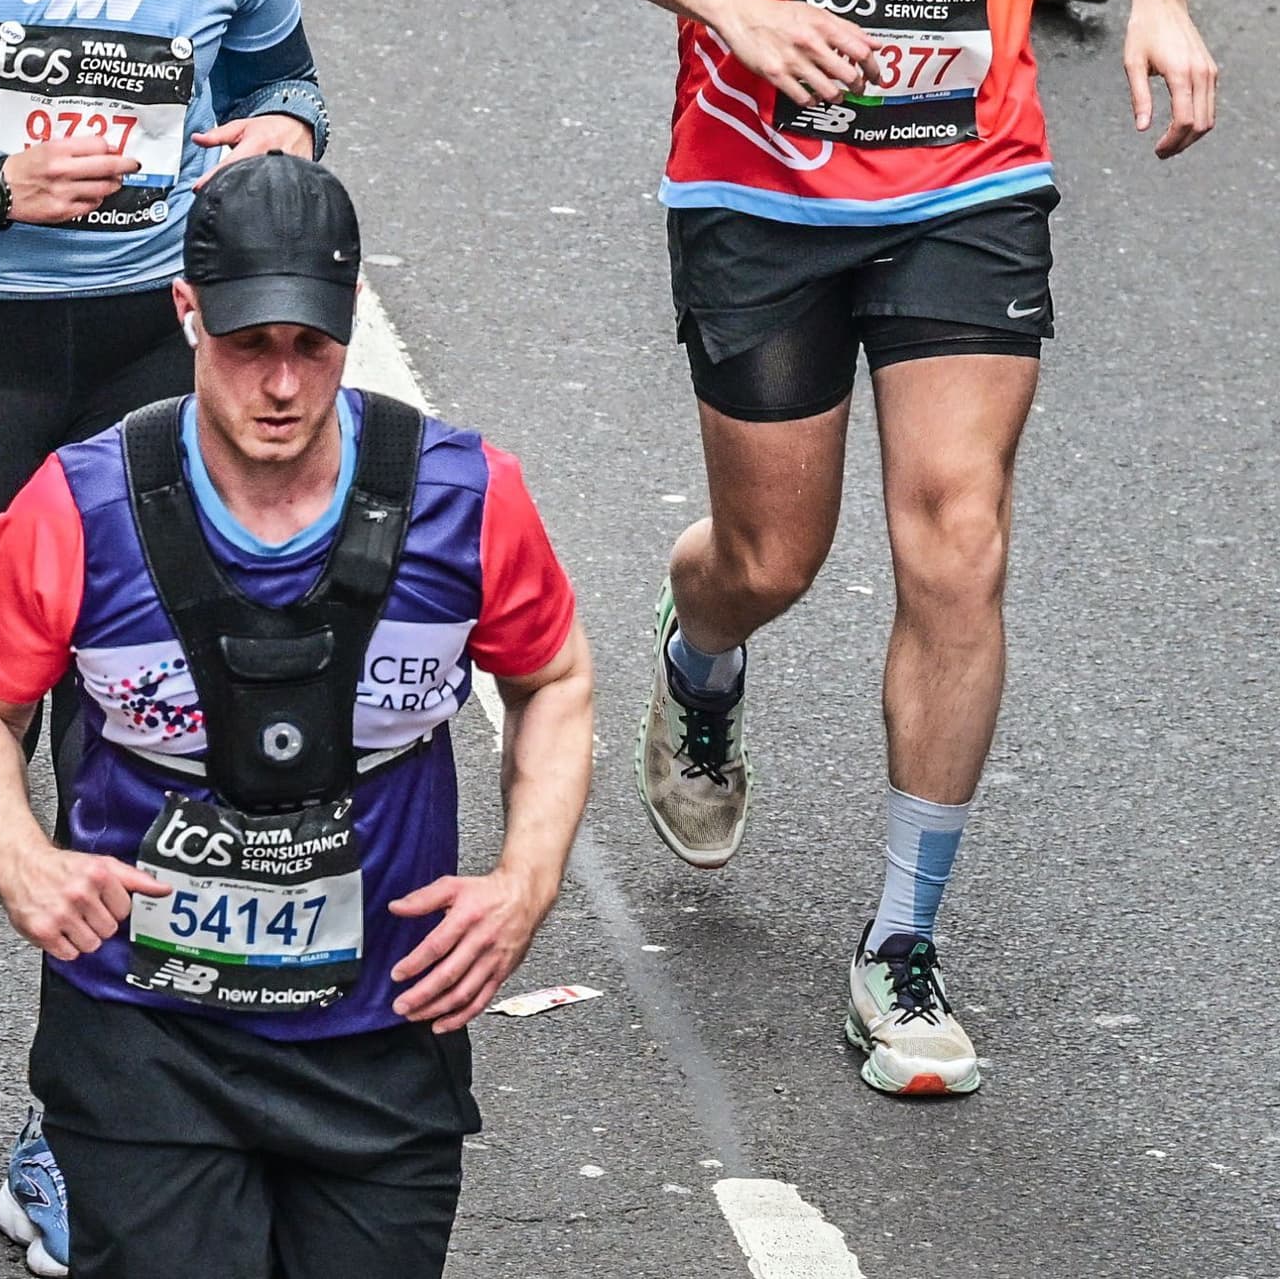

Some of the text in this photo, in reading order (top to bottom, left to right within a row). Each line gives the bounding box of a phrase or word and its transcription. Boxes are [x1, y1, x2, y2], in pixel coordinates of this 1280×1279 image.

[884, 5, 949, 20] SERVICES
[80, 40, 128, 58] TATA
[79, 57, 184, 81] CONSULTANCY
[878, 45, 961, 90] 377
[75, 72, 145, 93] SERVICES
[854, 121, 958, 141] new balance
[87, 206, 150, 226] balance
[155, 808, 235, 867] tcs
[241, 829, 351, 860] CONSULTANCY
[244, 827, 293, 845] TATA
[241, 857, 313, 875] SERVICES
[169, 890, 328, 947] 54147
[217, 985, 259, 1002] new
